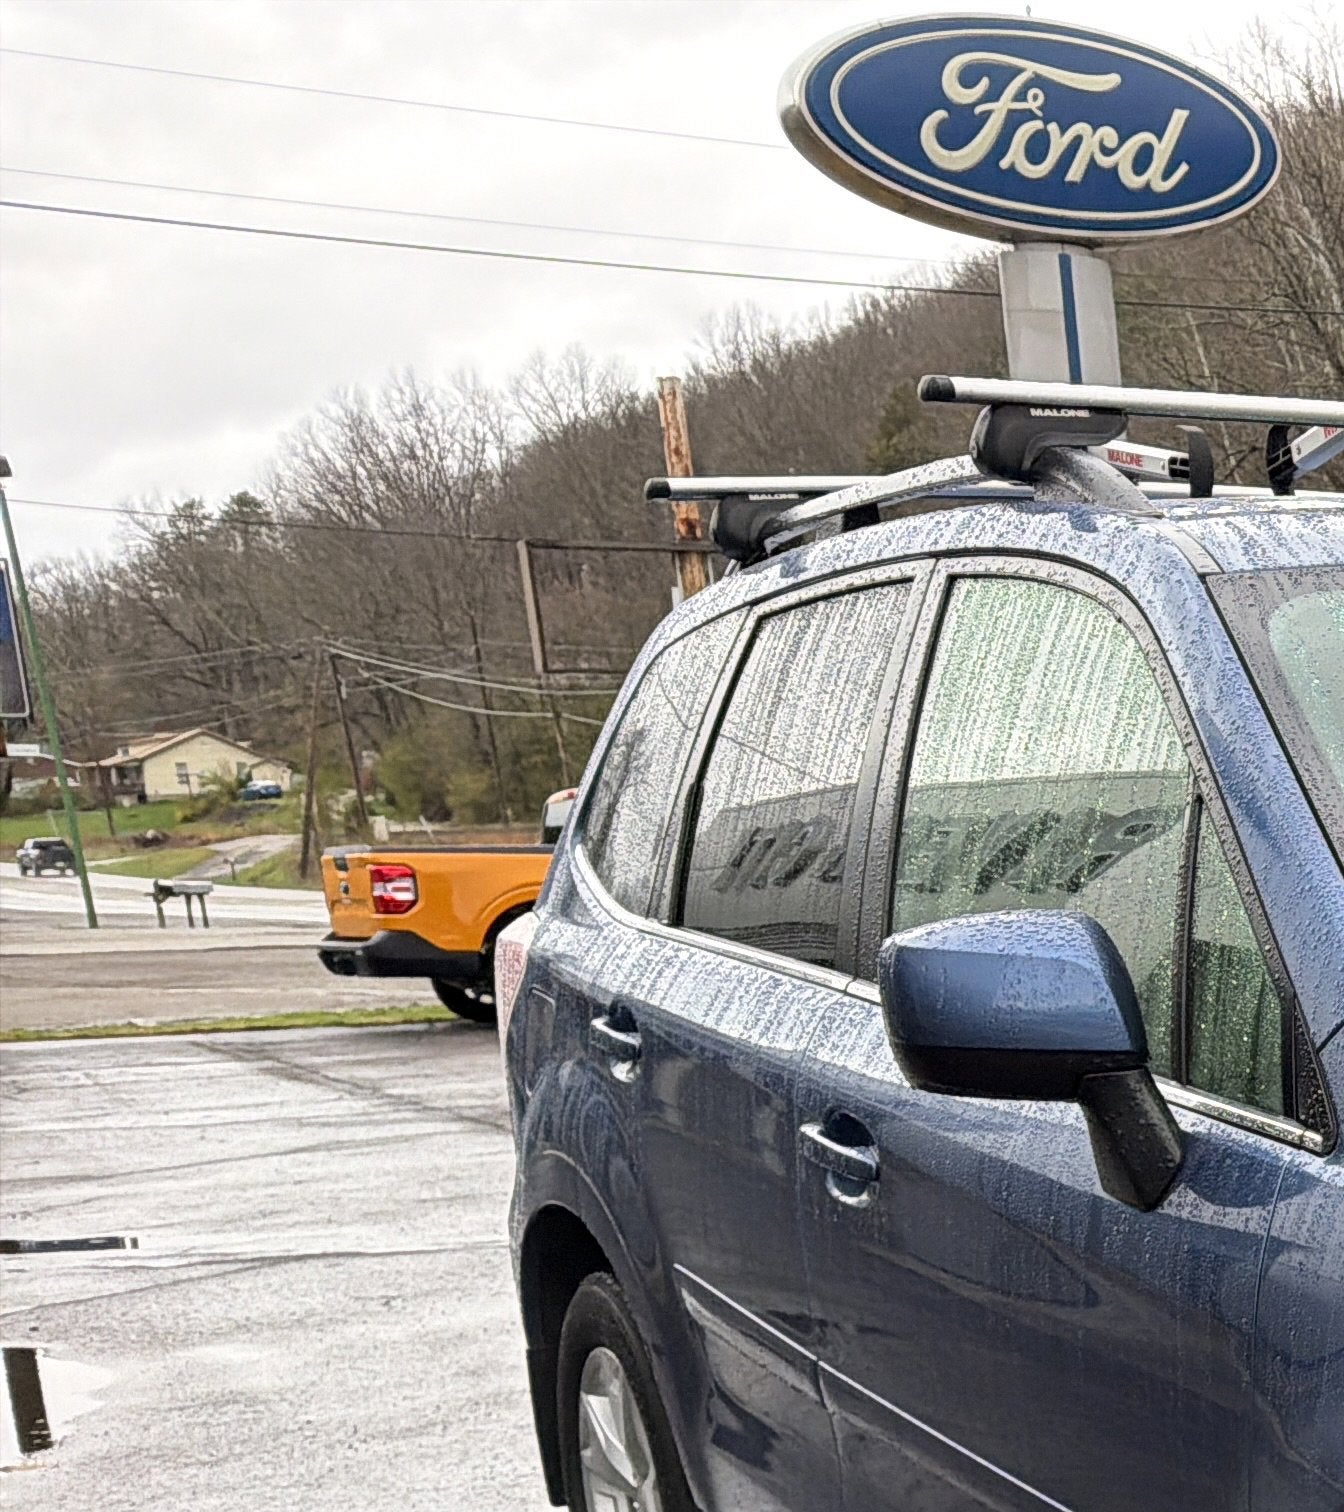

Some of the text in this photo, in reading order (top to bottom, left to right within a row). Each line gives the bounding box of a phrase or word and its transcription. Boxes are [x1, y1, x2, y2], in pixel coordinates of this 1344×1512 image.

[920, 51, 1190, 193] Ford
[1029, 407, 1091, 418] MALONE
[1106, 448, 1144, 468] MALONE
